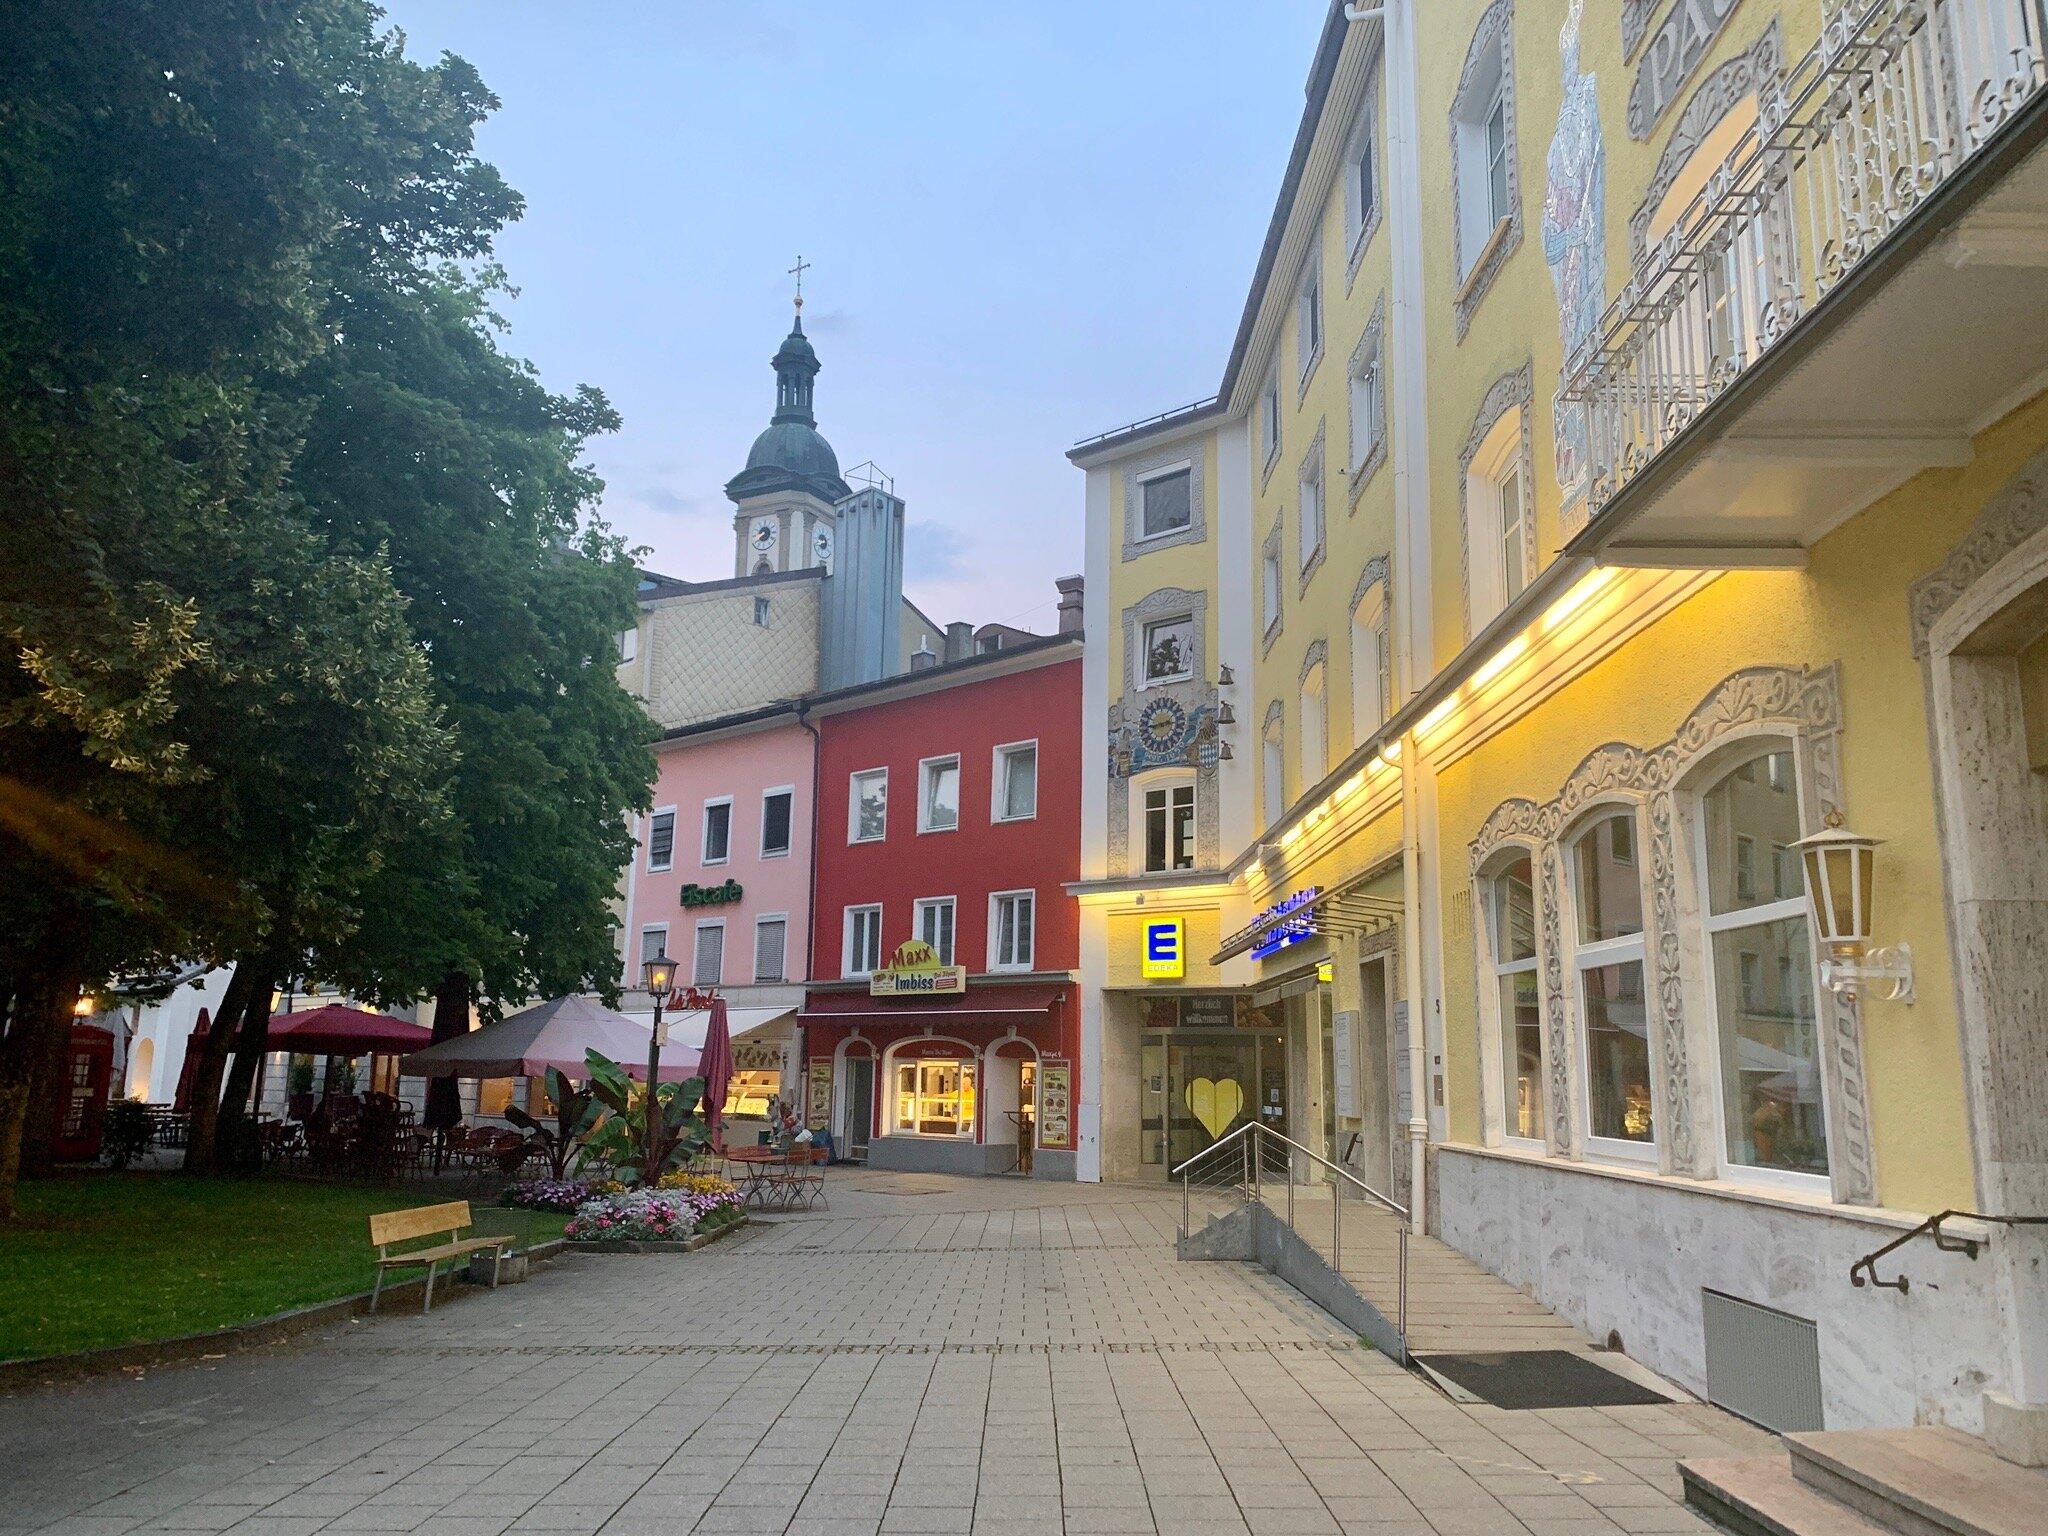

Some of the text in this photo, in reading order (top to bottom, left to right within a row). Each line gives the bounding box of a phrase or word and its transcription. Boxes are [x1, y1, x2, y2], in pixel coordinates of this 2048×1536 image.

[1651, 0, 1732, 116] PA
[1148, 924, 1177, 961] E
[891, 946, 931, 970] Maxx
[1148, 964, 1179, 972] EDEKA
[896, 973, 934, 991] Imbiss
